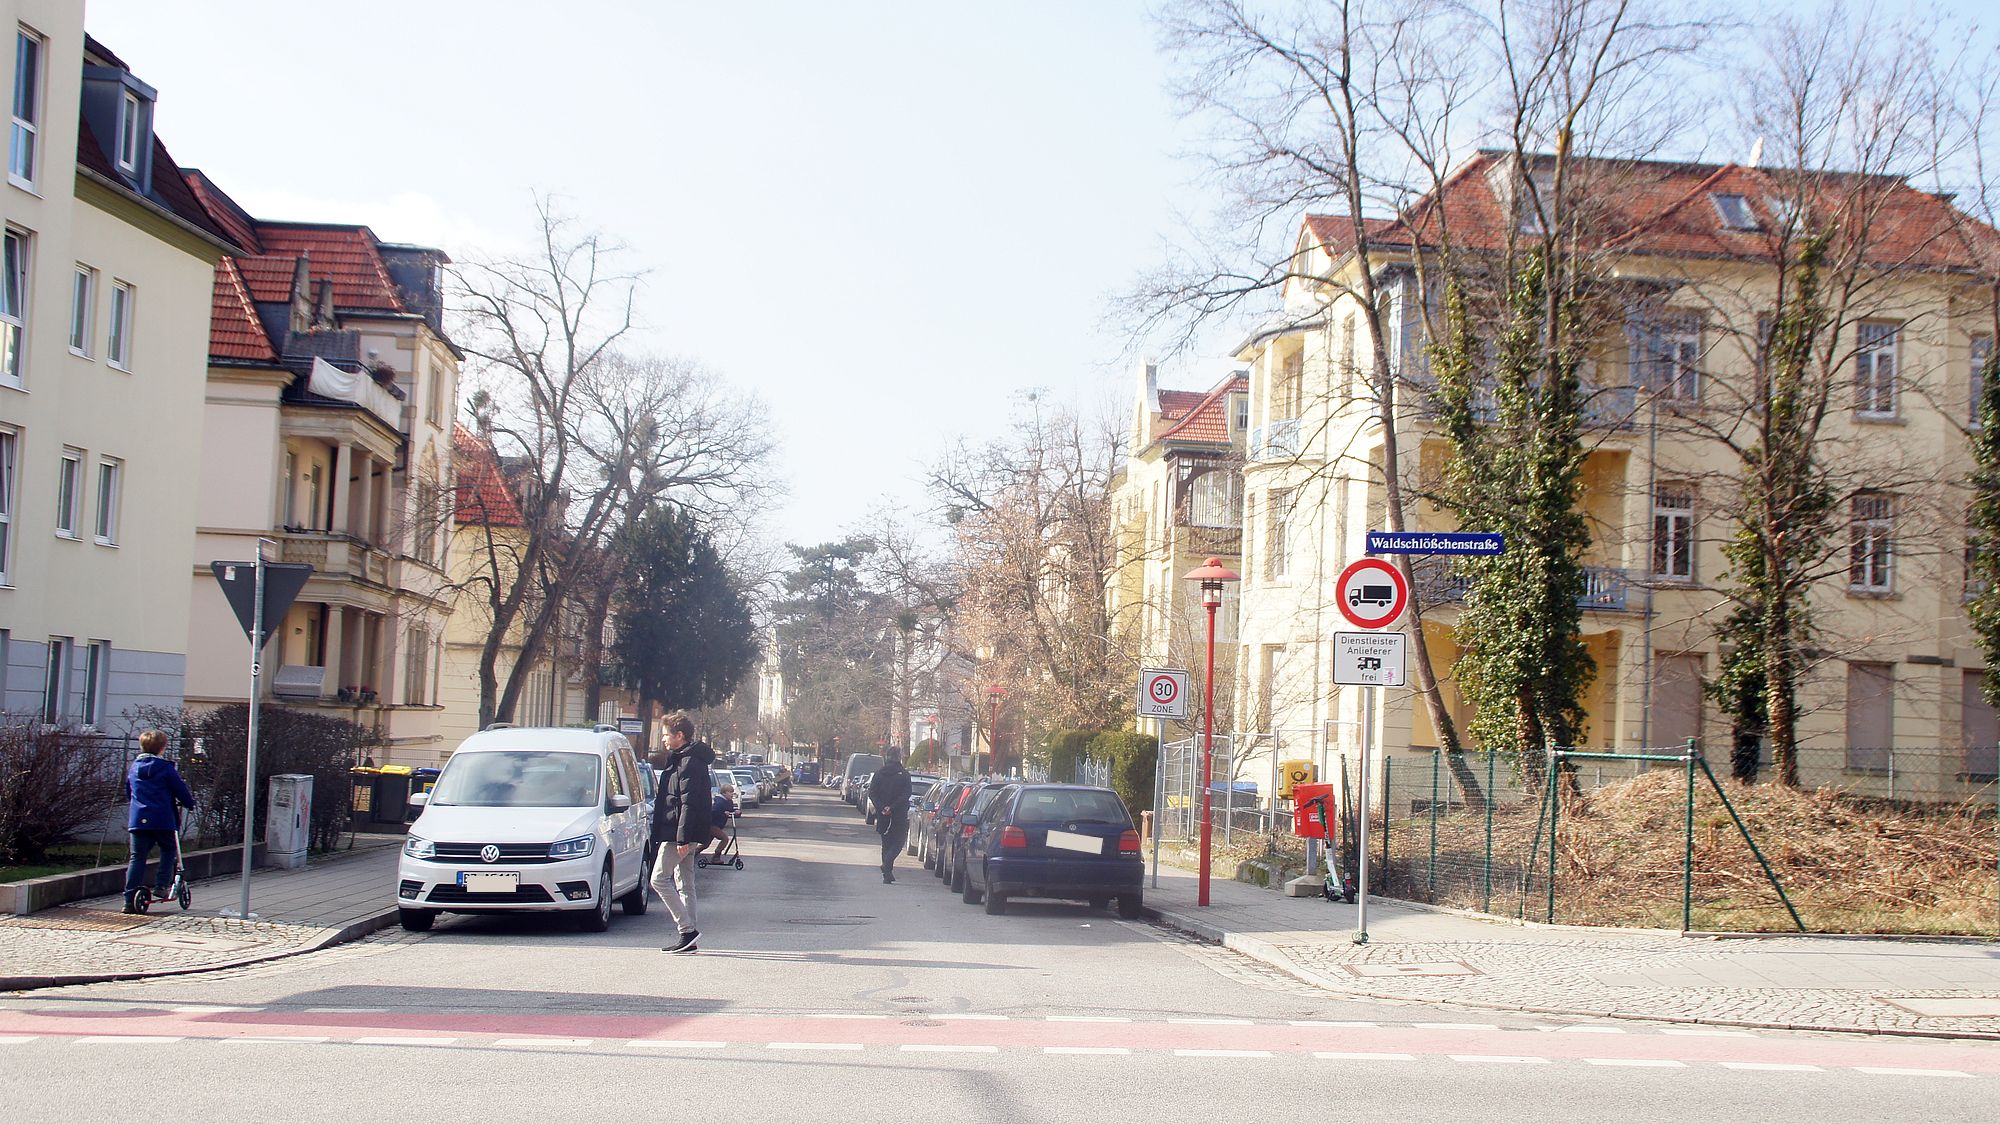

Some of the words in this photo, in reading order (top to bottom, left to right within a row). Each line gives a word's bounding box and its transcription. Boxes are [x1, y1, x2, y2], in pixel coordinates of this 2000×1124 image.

[1370, 537, 1499, 550] Waldschlößchenstraße
[1341, 636, 1398, 646] Dienstleister
[1347, 646, 1392, 655] Anlieferer
[1361, 673, 1377, 681] frei
[1155, 683, 1172, 696] 30
[1152, 705, 1173, 713] ZONE
[481, 844, 500, 863] VW
